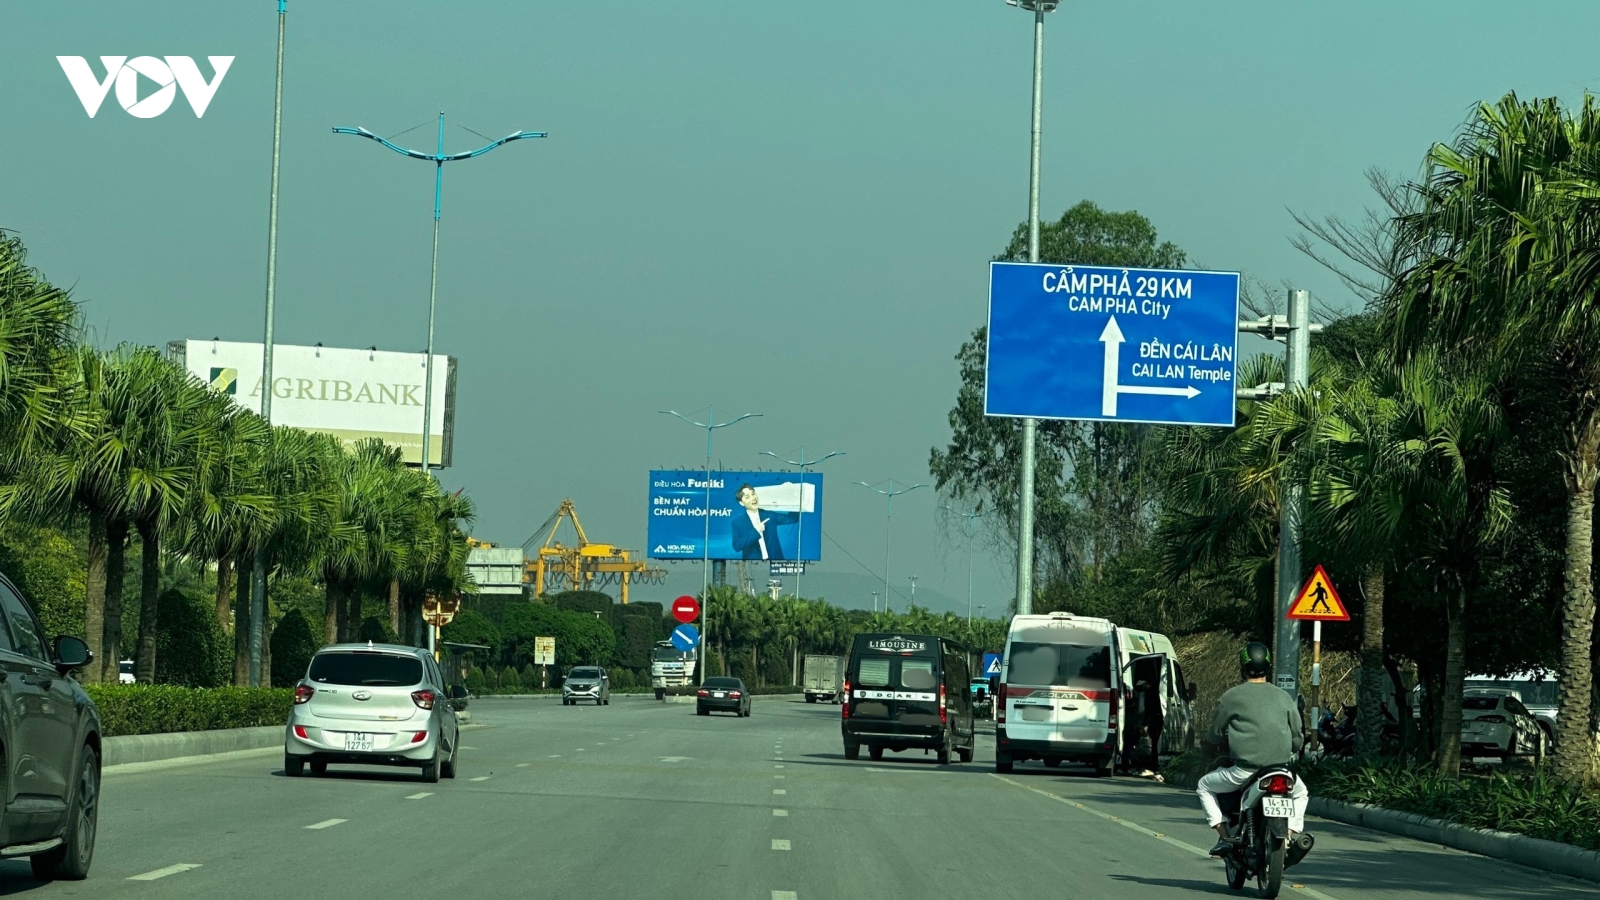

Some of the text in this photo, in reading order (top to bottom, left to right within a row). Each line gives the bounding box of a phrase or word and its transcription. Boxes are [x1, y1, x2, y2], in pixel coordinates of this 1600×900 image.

[1136, 277, 1157, 297] 29
[1161, 278, 1192, 299] KM
[1069, 296, 1170, 319] CAM PHA City
[1140, 337, 1232, 362] ĐỀN CÁI LÂN
[1132, 363, 1231, 383] CAI LAN Temple
[249, 376, 423, 406] AGRIBANK
[687, 478, 724, 488] Funiki
[654, 496, 690, 505] BỀN MÁT
[653, 506, 732, 517] CHUẨN HÒA PHÁT
[869, 641, 925, 649] LIMOUSINE
[1267, 798, 1290, 807] 14-X1
